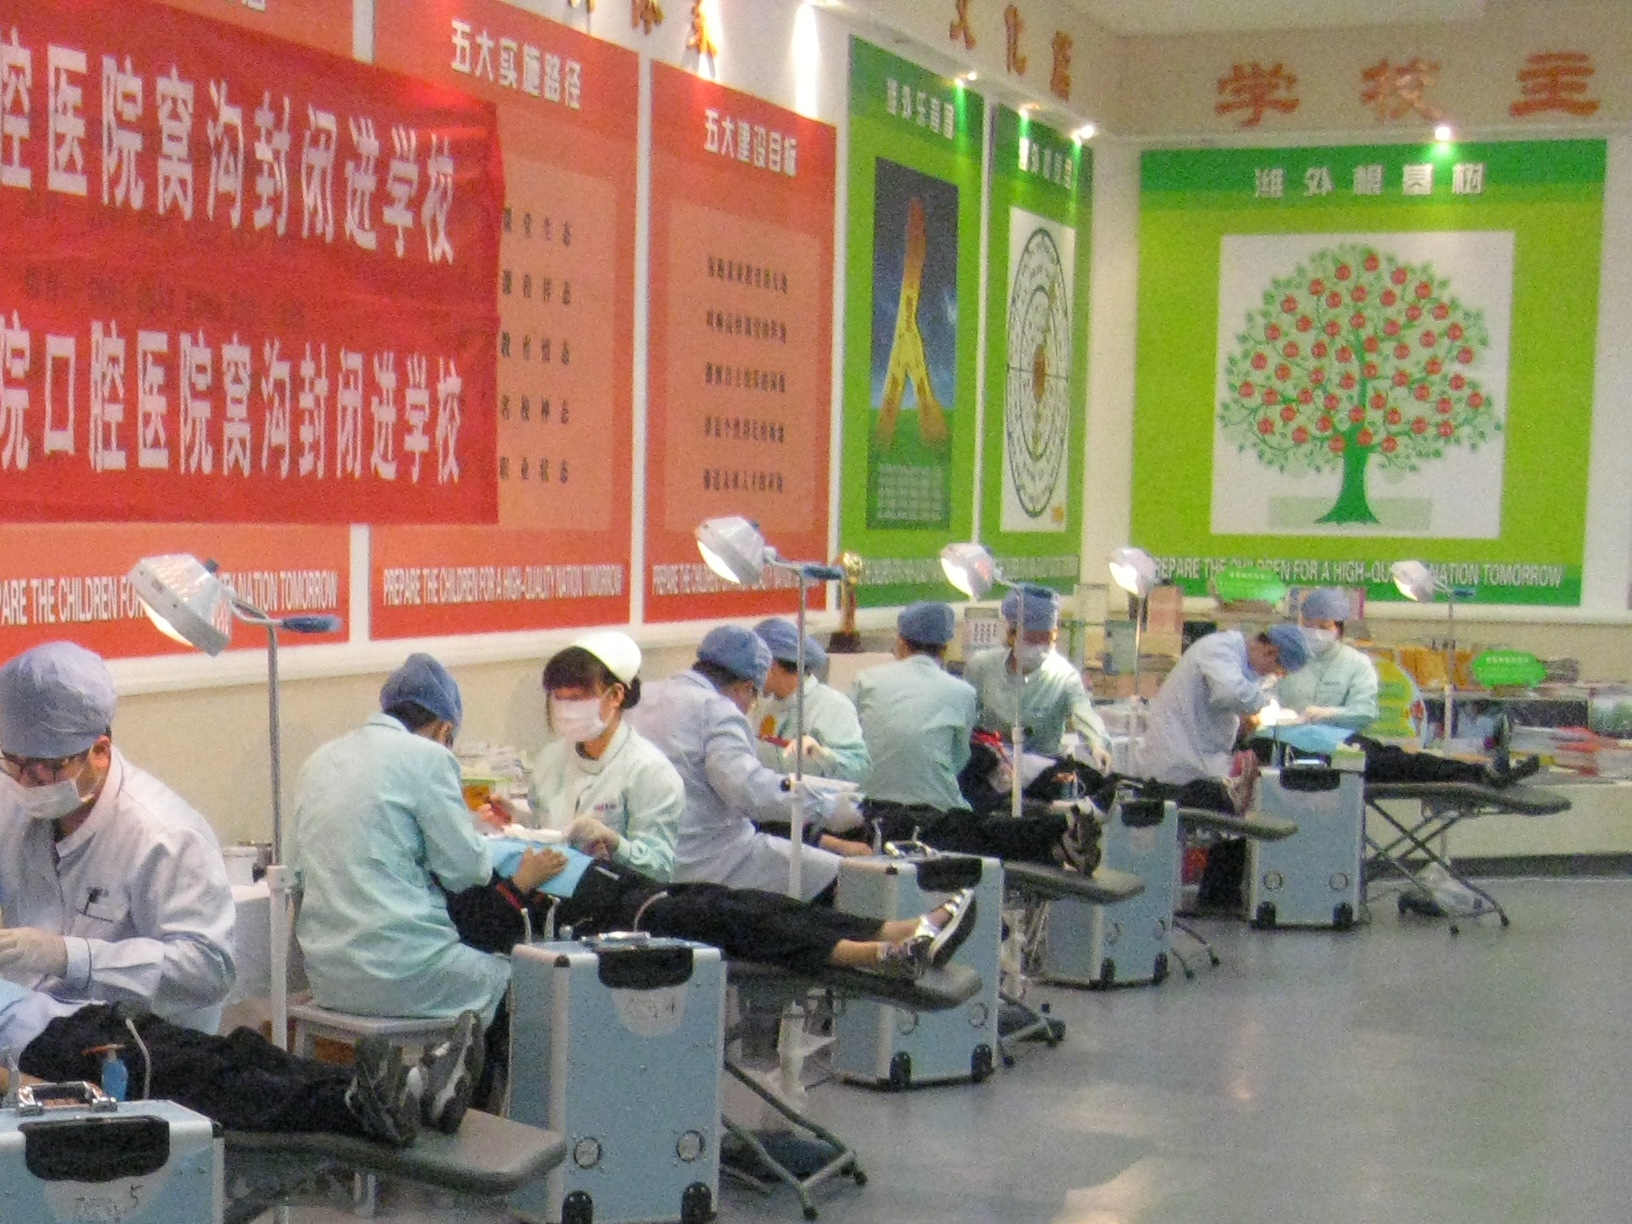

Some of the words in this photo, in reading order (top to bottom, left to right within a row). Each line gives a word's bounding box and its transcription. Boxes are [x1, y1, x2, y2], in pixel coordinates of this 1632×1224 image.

[1154, 557, 1200, 579] REPARE
[1483, 564, 1563, 588] TOMORROW
[30, 577, 57, 625] THE
[58, 576, 119, 623] CHILDREN
[237, 572, 278, 613] NATION
[278, 570, 339, 611] TOMORROW
